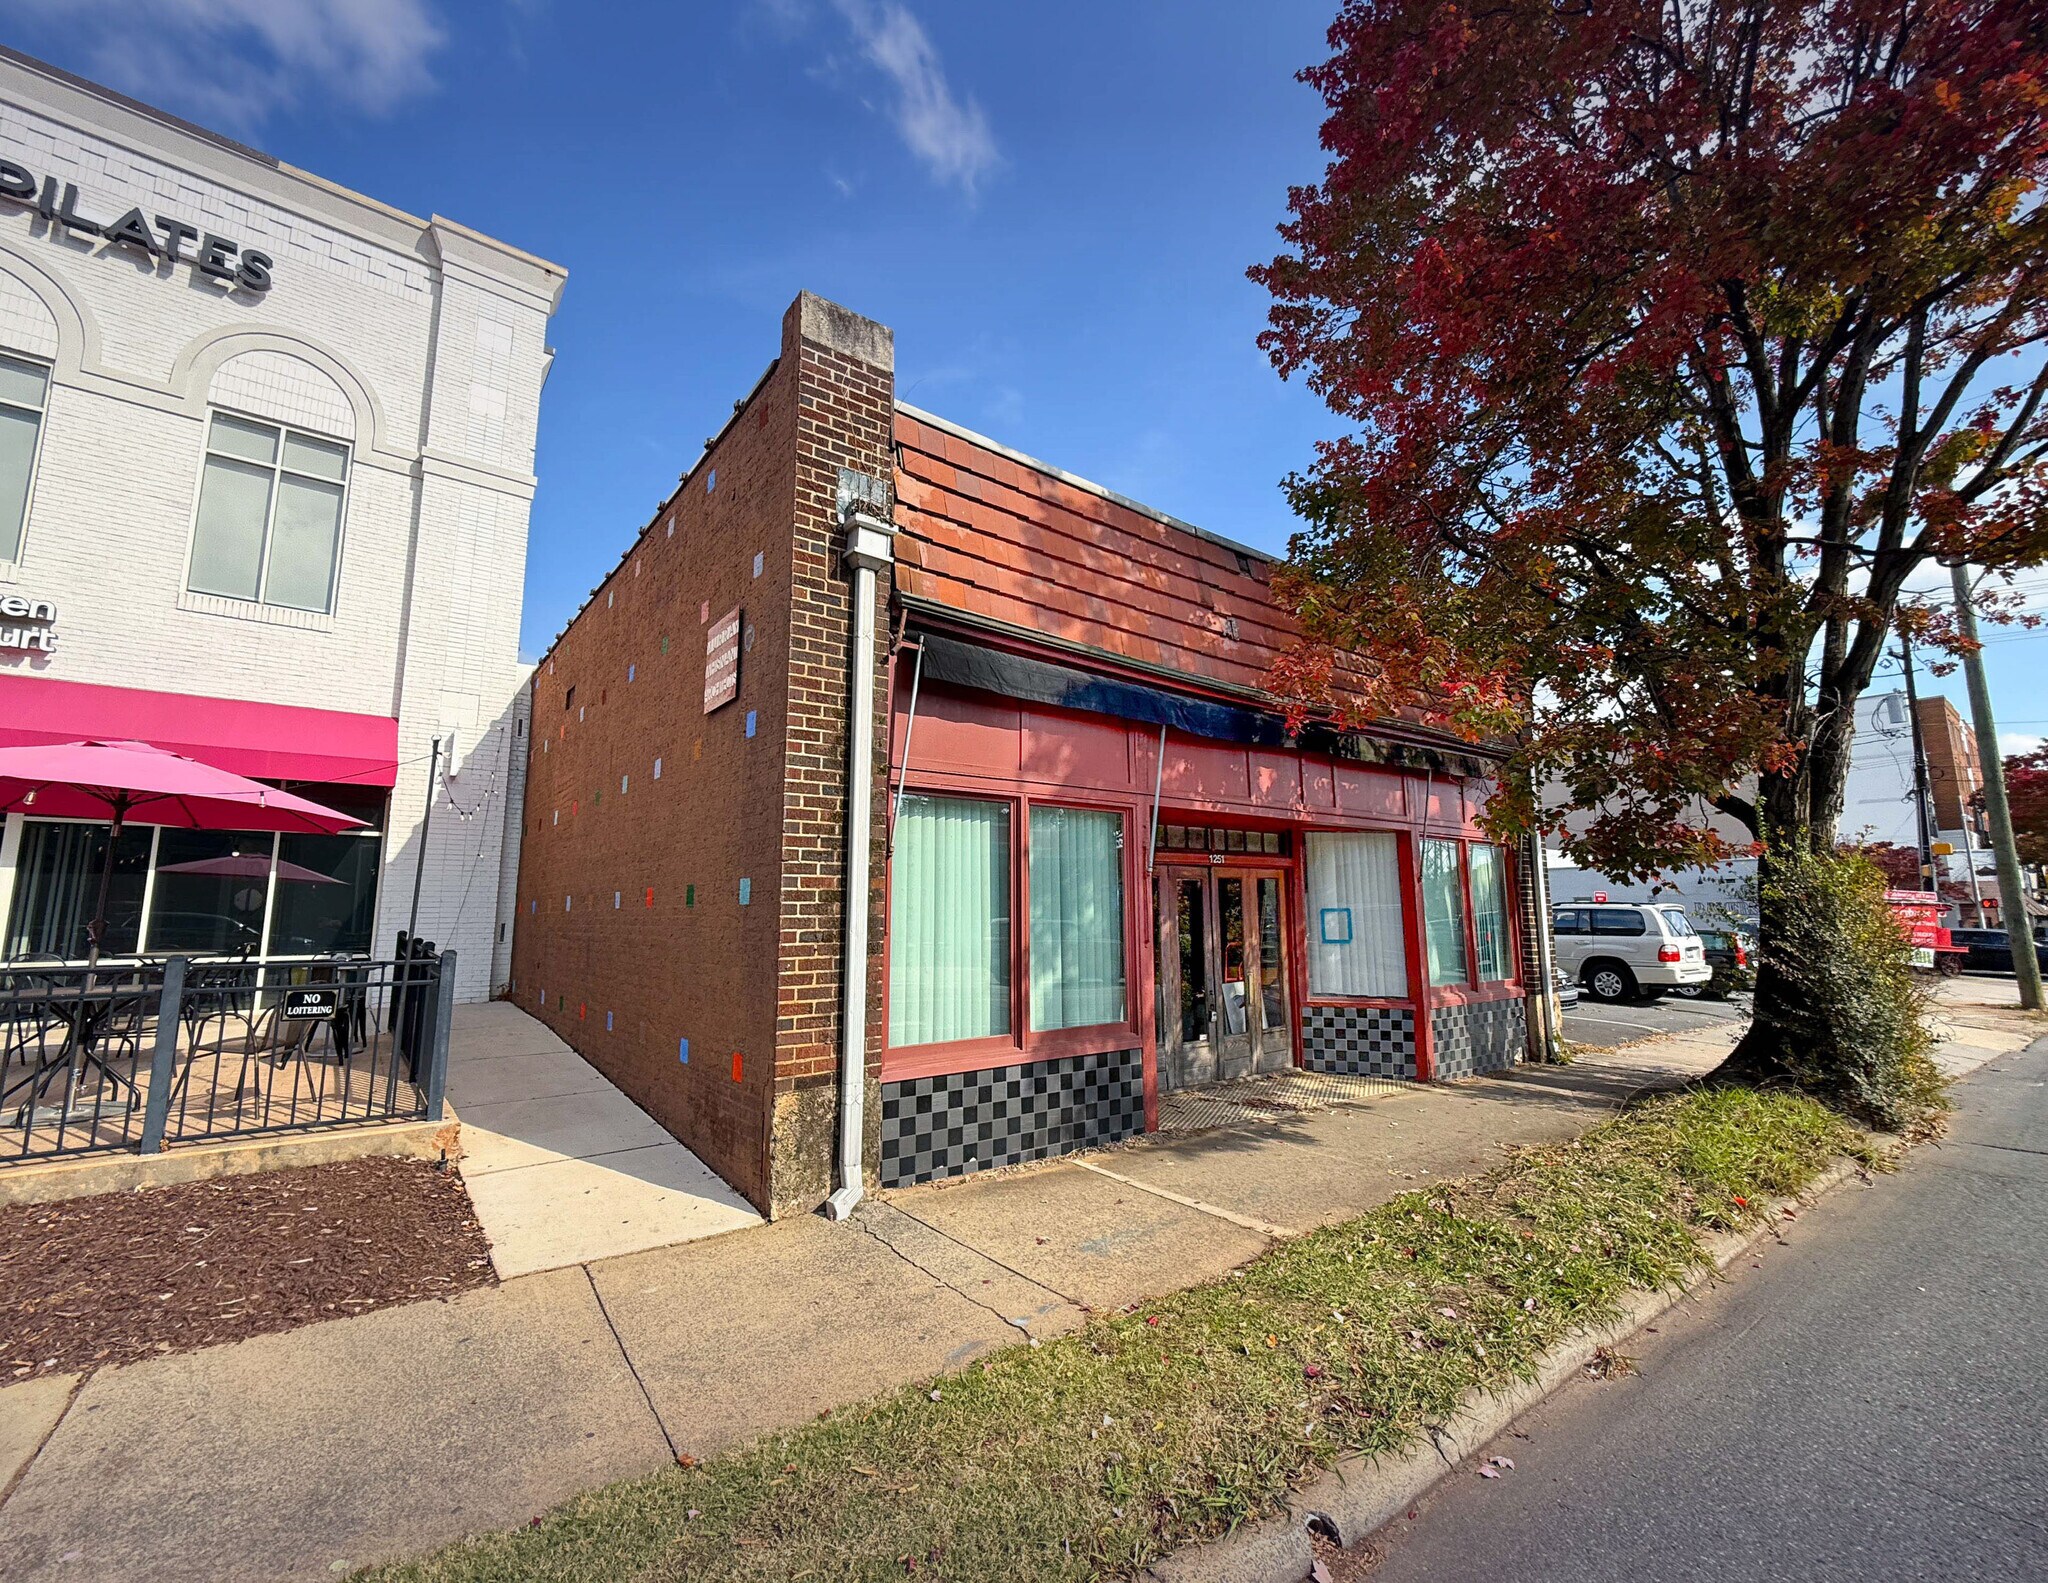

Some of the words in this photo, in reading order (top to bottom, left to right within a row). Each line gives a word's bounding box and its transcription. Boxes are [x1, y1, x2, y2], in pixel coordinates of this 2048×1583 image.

[0, 594, 57, 622] en
[1209, 854, 1225, 864] 1251
[303, 993, 321, 1004] NO
[287, 1006, 333, 1015] LOITERING
